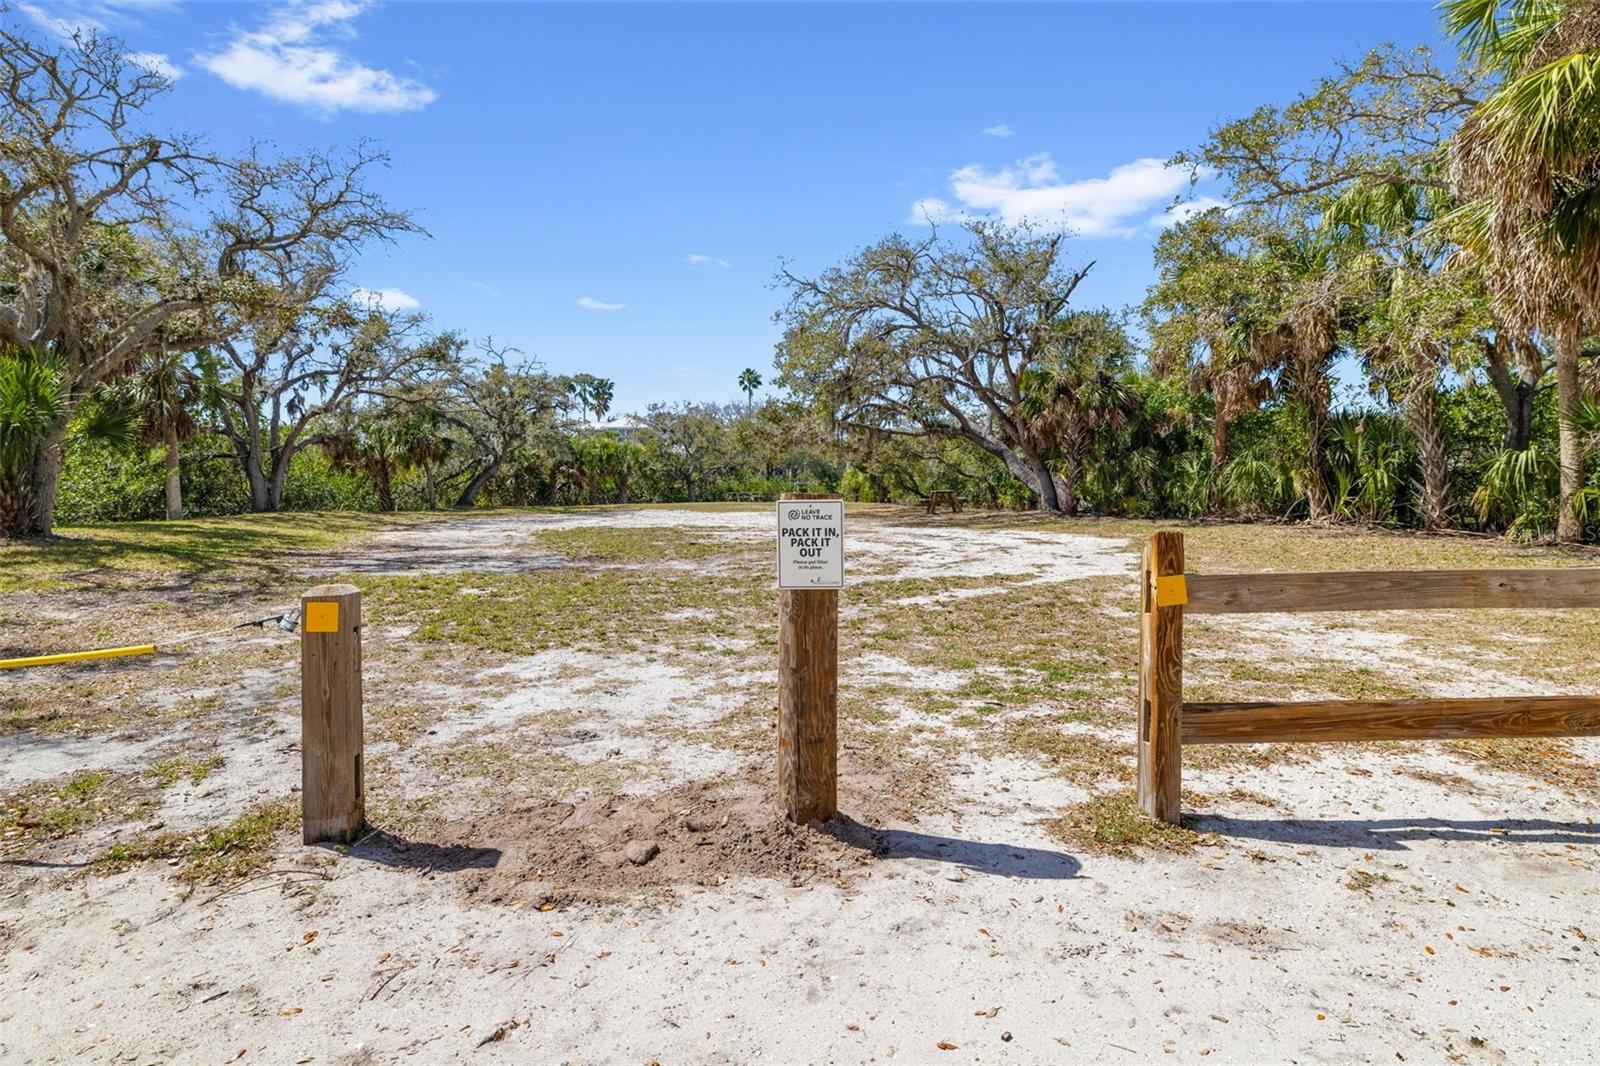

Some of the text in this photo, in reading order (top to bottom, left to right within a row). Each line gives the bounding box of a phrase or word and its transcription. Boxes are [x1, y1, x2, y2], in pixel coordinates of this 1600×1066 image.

[782, 528, 839, 538] PACK IT IN,
[791, 538, 831, 547] PACK IT
[800, 548, 822, 557] OUT
